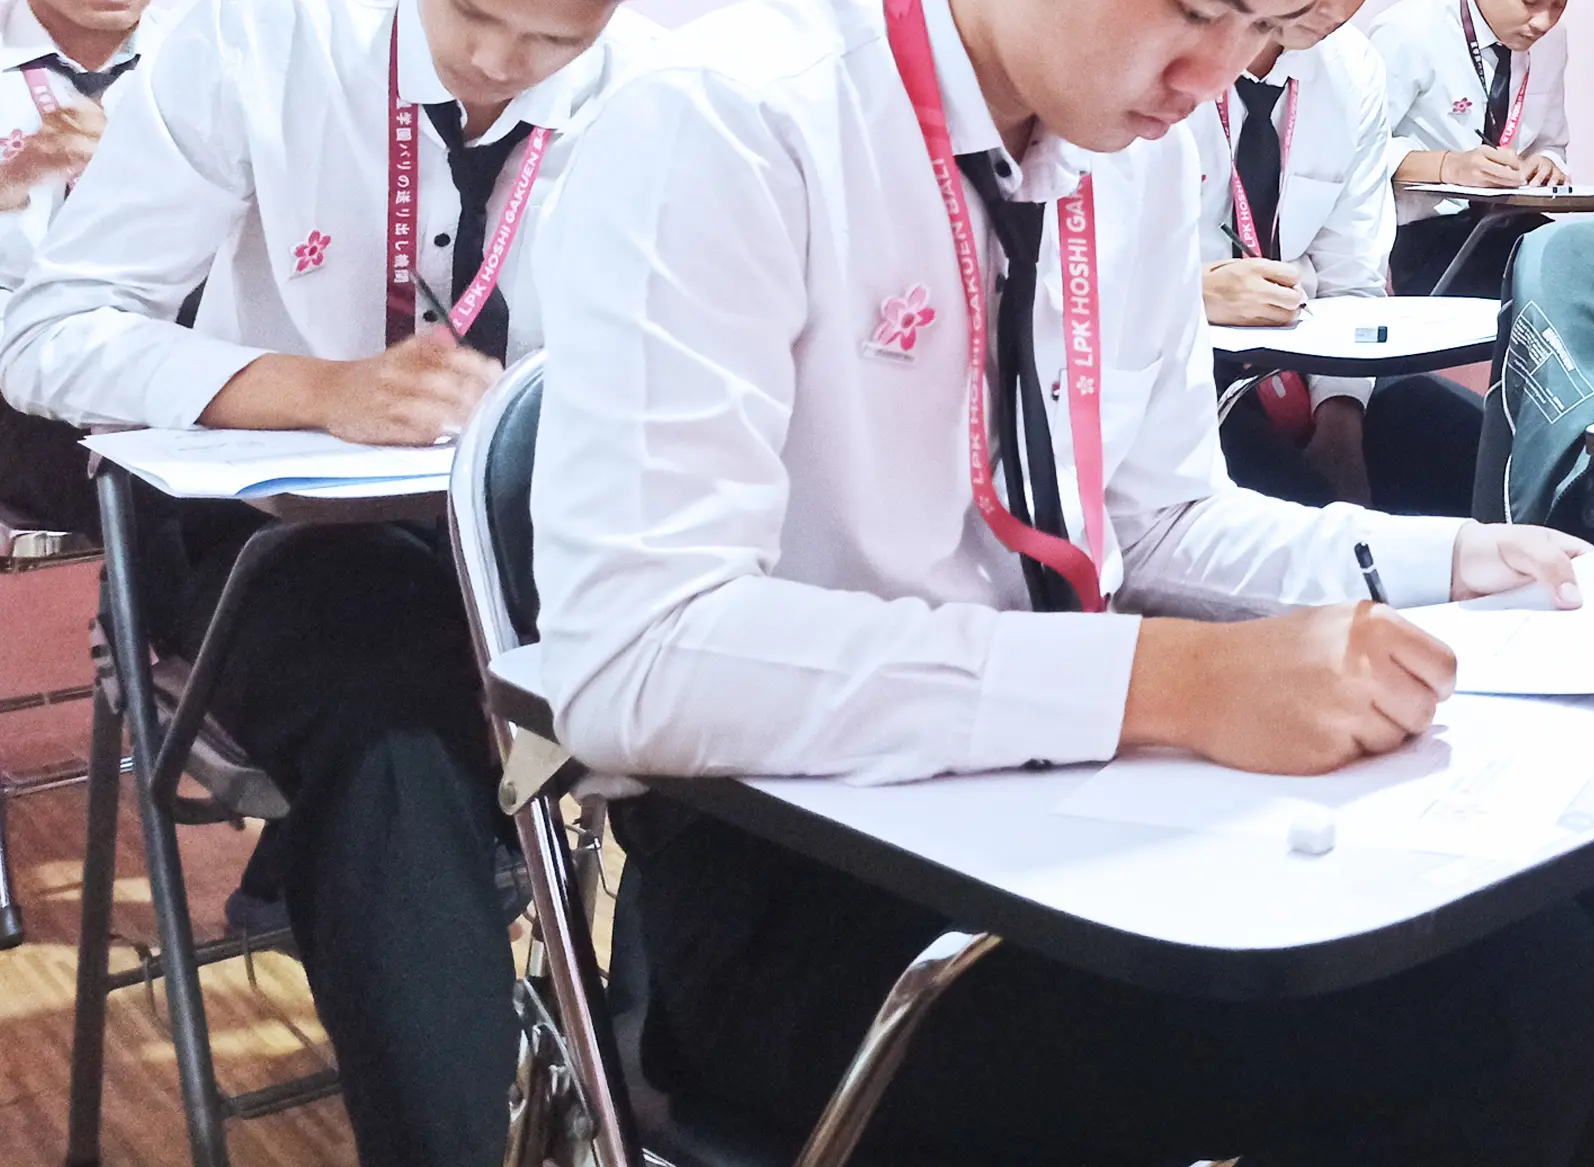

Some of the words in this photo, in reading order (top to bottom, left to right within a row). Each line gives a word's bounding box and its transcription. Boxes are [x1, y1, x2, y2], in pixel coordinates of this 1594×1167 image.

[932, 157, 960, 216] BALI
[1235, 180, 1250, 221] HOSHI
[457, 281, 487, 317] LPK
[481, 225, 512, 283] HOSHI
[504, 154, 540, 225] GAKUEN
[1242, 223, 1257, 248] LPK
[953, 219, 983, 331] GAKUEN
[1068, 238, 1090, 317] HOSHI
[1073, 319, 1093, 367] LPK
[969, 339, 982, 424] HOSHI
[970, 432, 985, 485] LPK
